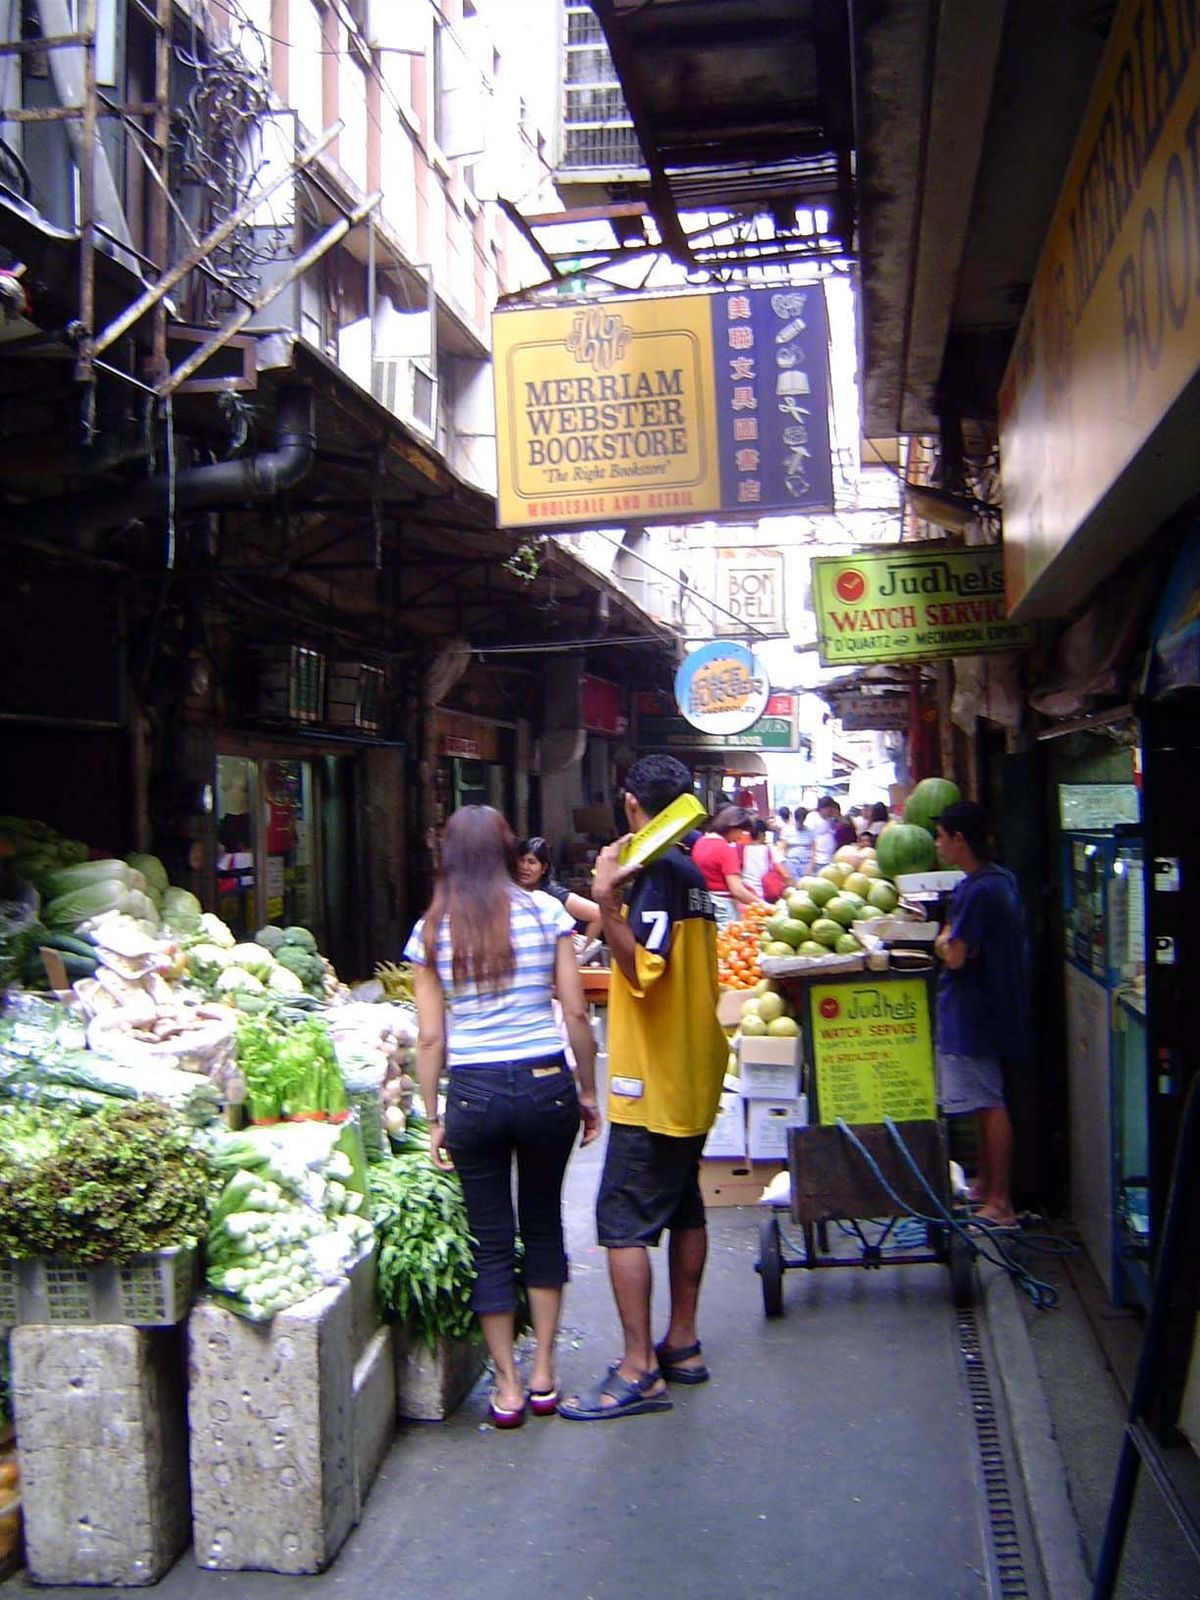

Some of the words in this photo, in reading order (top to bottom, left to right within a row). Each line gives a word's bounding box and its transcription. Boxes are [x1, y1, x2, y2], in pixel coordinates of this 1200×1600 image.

[525, 369, 684, 408] MERRIAM
[526, 399, 685, 436] WEBSTER
[528, 428, 688, 466] BOOKSTORE
[573, 465, 606, 486] Right
[527, 497, 605, 518] WHOLESALE
[613, 494, 641, 512] AND
[647, 491, 694, 509] RETAIL
[828, 606, 917, 634] WATCH
[926, 600, 1006, 628] SERVIC
[641, 911, 668, 950] 7
[820, 1027, 862, 1040] WATCH
[869, 1023, 918, 1037] SERVICE
